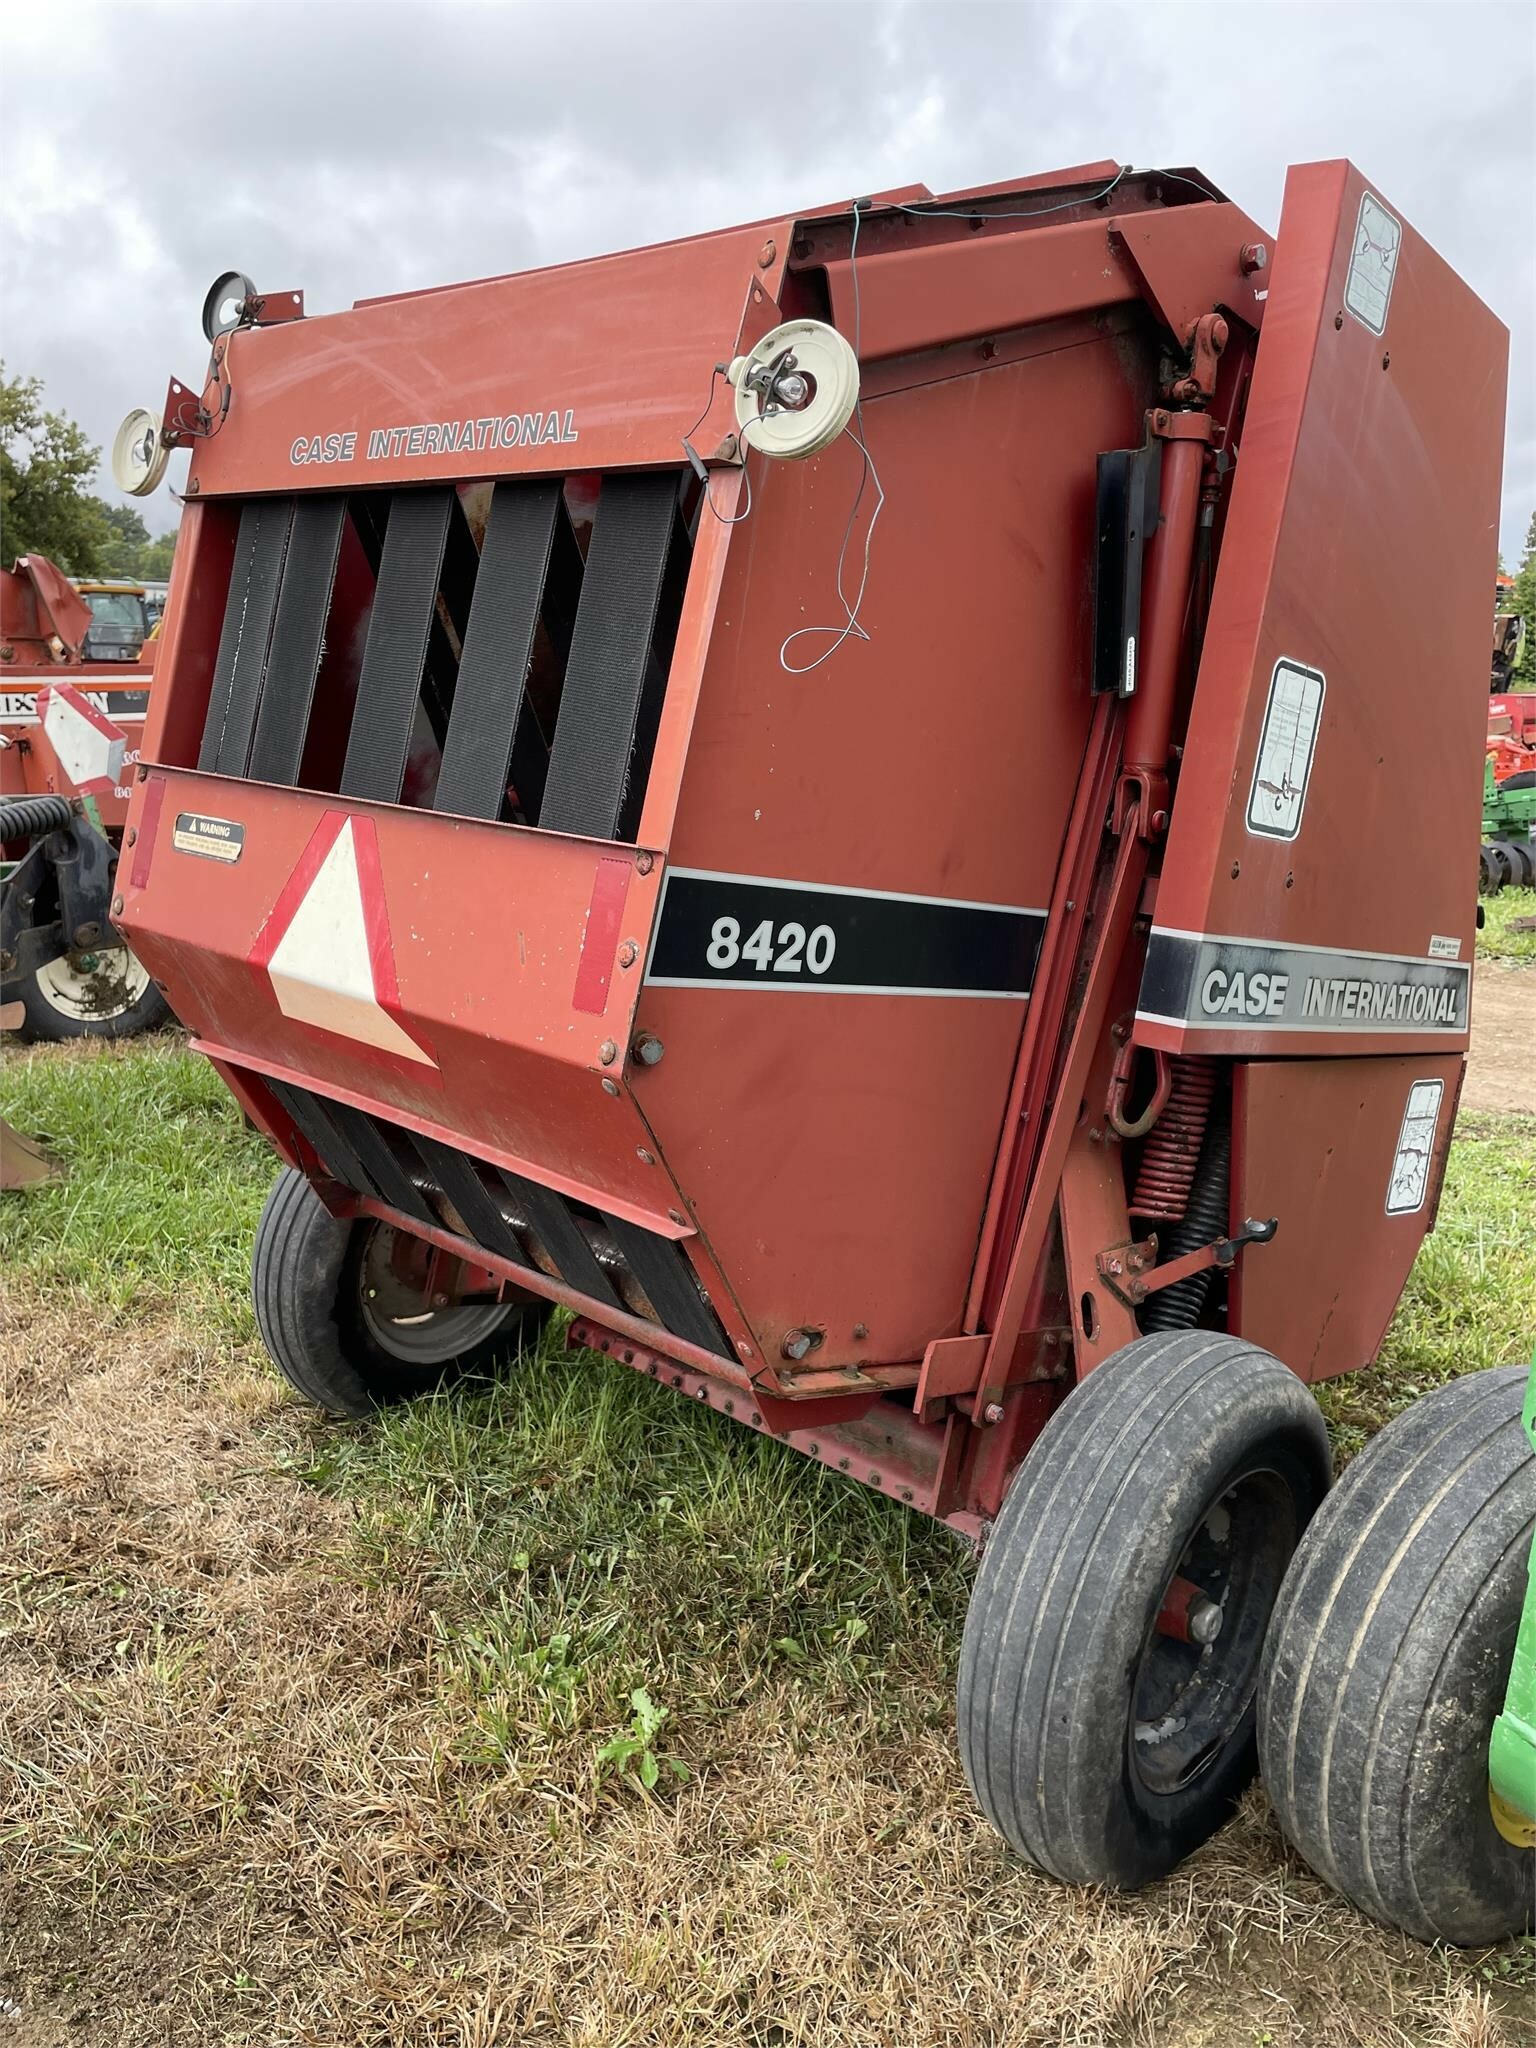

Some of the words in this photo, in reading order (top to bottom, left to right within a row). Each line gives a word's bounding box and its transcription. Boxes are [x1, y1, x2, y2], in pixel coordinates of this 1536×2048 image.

[290, 432, 357, 466] CASE
[366, 409, 579, 459] INTERNATIONAL
[199, 821, 231, 838] WARNING
[706, 916, 836, 974] 8420
[1201, 969, 1289, 1016] CASE
[1302, 977, 1456, 1021] INTERNATIONAL
